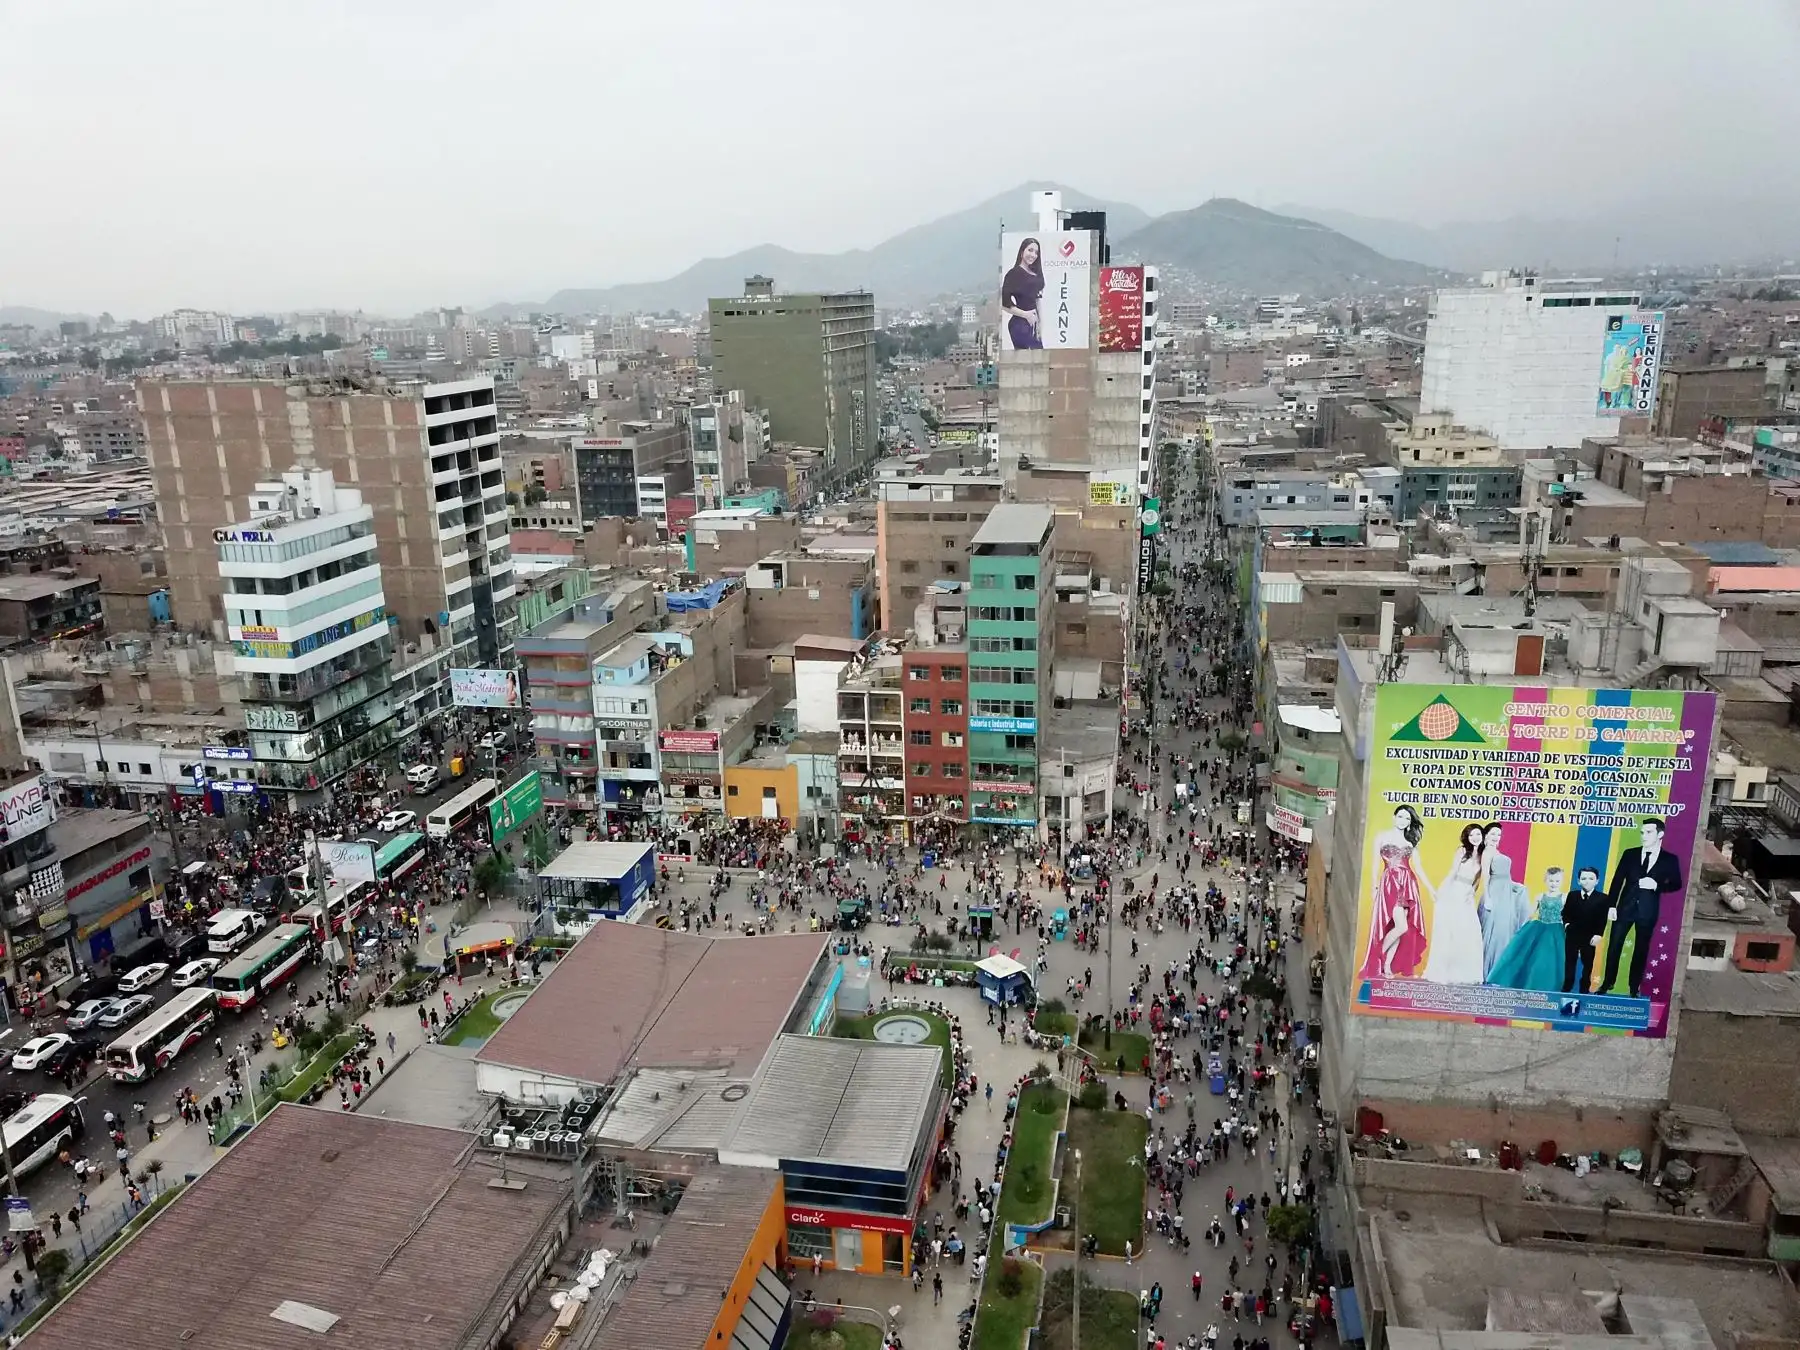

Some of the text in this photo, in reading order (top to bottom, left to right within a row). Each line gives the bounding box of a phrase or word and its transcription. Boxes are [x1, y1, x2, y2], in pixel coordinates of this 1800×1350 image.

[1069, 260, 1087, 268] PLAZA
[1058, 272, 1069, 343] JEANS
[1642, 325, 1658, 334] EL
[1638, 335, 1657, 409] ENCANTO
[1140, 538, 1151, 585] JULIOS
[1504, 703, 1674, 720] CENTRO COMERCIAL
[608, 720, 649, 728] CORTINAS
[1513, 725, 1569, 739] TORRE
[1575, 728, 1597, 741] DE
[1386, 748, 1692, 770] EXCLUSIVIDAD Y VARIEDAD DE VESTIDOS DE FIESTA
[1402, 764, 1409, 773] Y
[1413, 764, 1444, 775] ROPA
[1448, 766, 1465, 776] DE
[1469, 765, 1514, 778] VESTIR
[1518, 768, 1550, 780] PARA
[1554, 769, 1588, 781] TODA
[1410, 778, 1658, 799] CONTAMOS CON MAS DE 200 TIENDAS.
[2, 787, 40, 812] MYA
[1423, 793, 1448, 804] BIEN
[1451, 795, 1467, 805] NO
[1470, 795, 1499, 806] SOLO
[1502, 797, 1517, 808] ES
[1580, 800, 1597, 811] DE
[1599, 802, 1615, 812] UN
[5, 800, 43, 826] LINE
[1275, 807, 1303, 825] CORTINAS
[1423, 807, 1436, 817] EL
[1440, 808, 1490, 820] VESTIDO
[1493, 810, 1555, 823] PERFECTO
[1557, 814, 1565, 823] A
[1568, 814, 1585, 825] TU
[1276, 821, 1299, 837] CORTINAS
[65, 847, 152, 903] MAQUICENTRO
[791, 1212, 820, 1224] Claro
